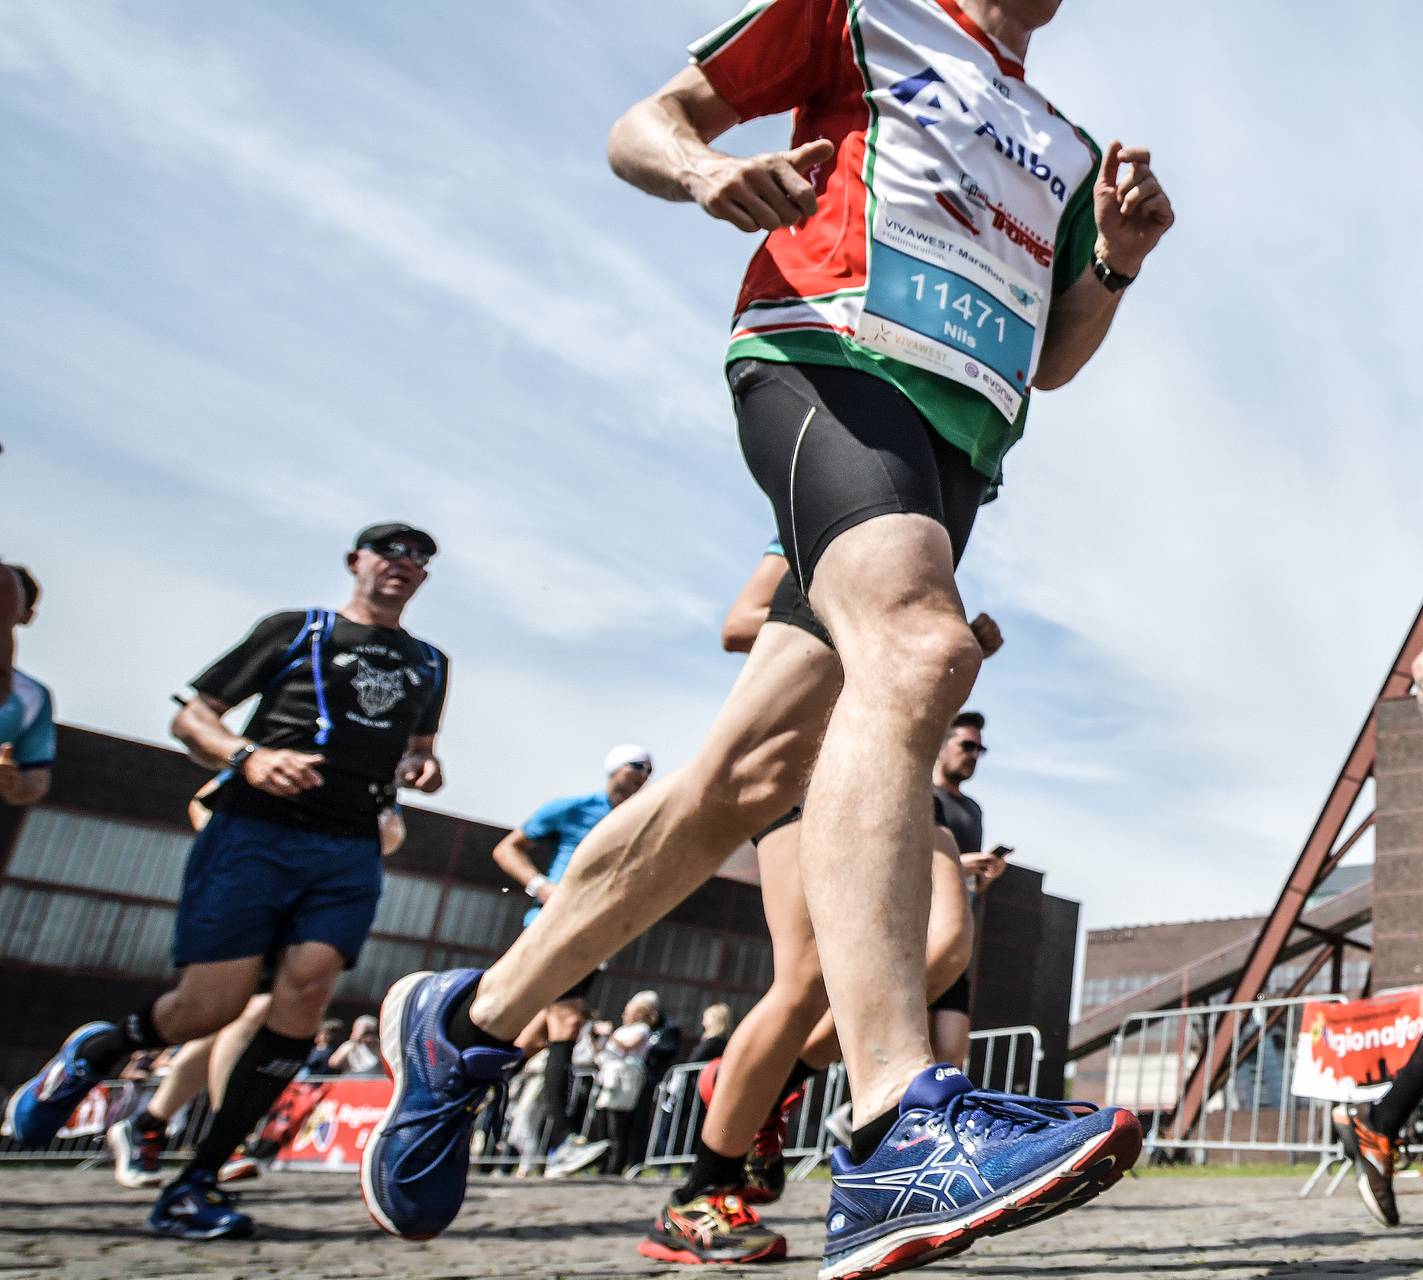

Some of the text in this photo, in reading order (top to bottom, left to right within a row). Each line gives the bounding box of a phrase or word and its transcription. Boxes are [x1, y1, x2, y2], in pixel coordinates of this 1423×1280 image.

[974, 121, 1068, 203] Allba
[884, 217, 1006, 286] VIVAWEST-Marathon
[910, 273, 1006, 344] 11471
[943, 320, 978, 349] Nils
[894, 333, 948, 362] VIVAWEST
